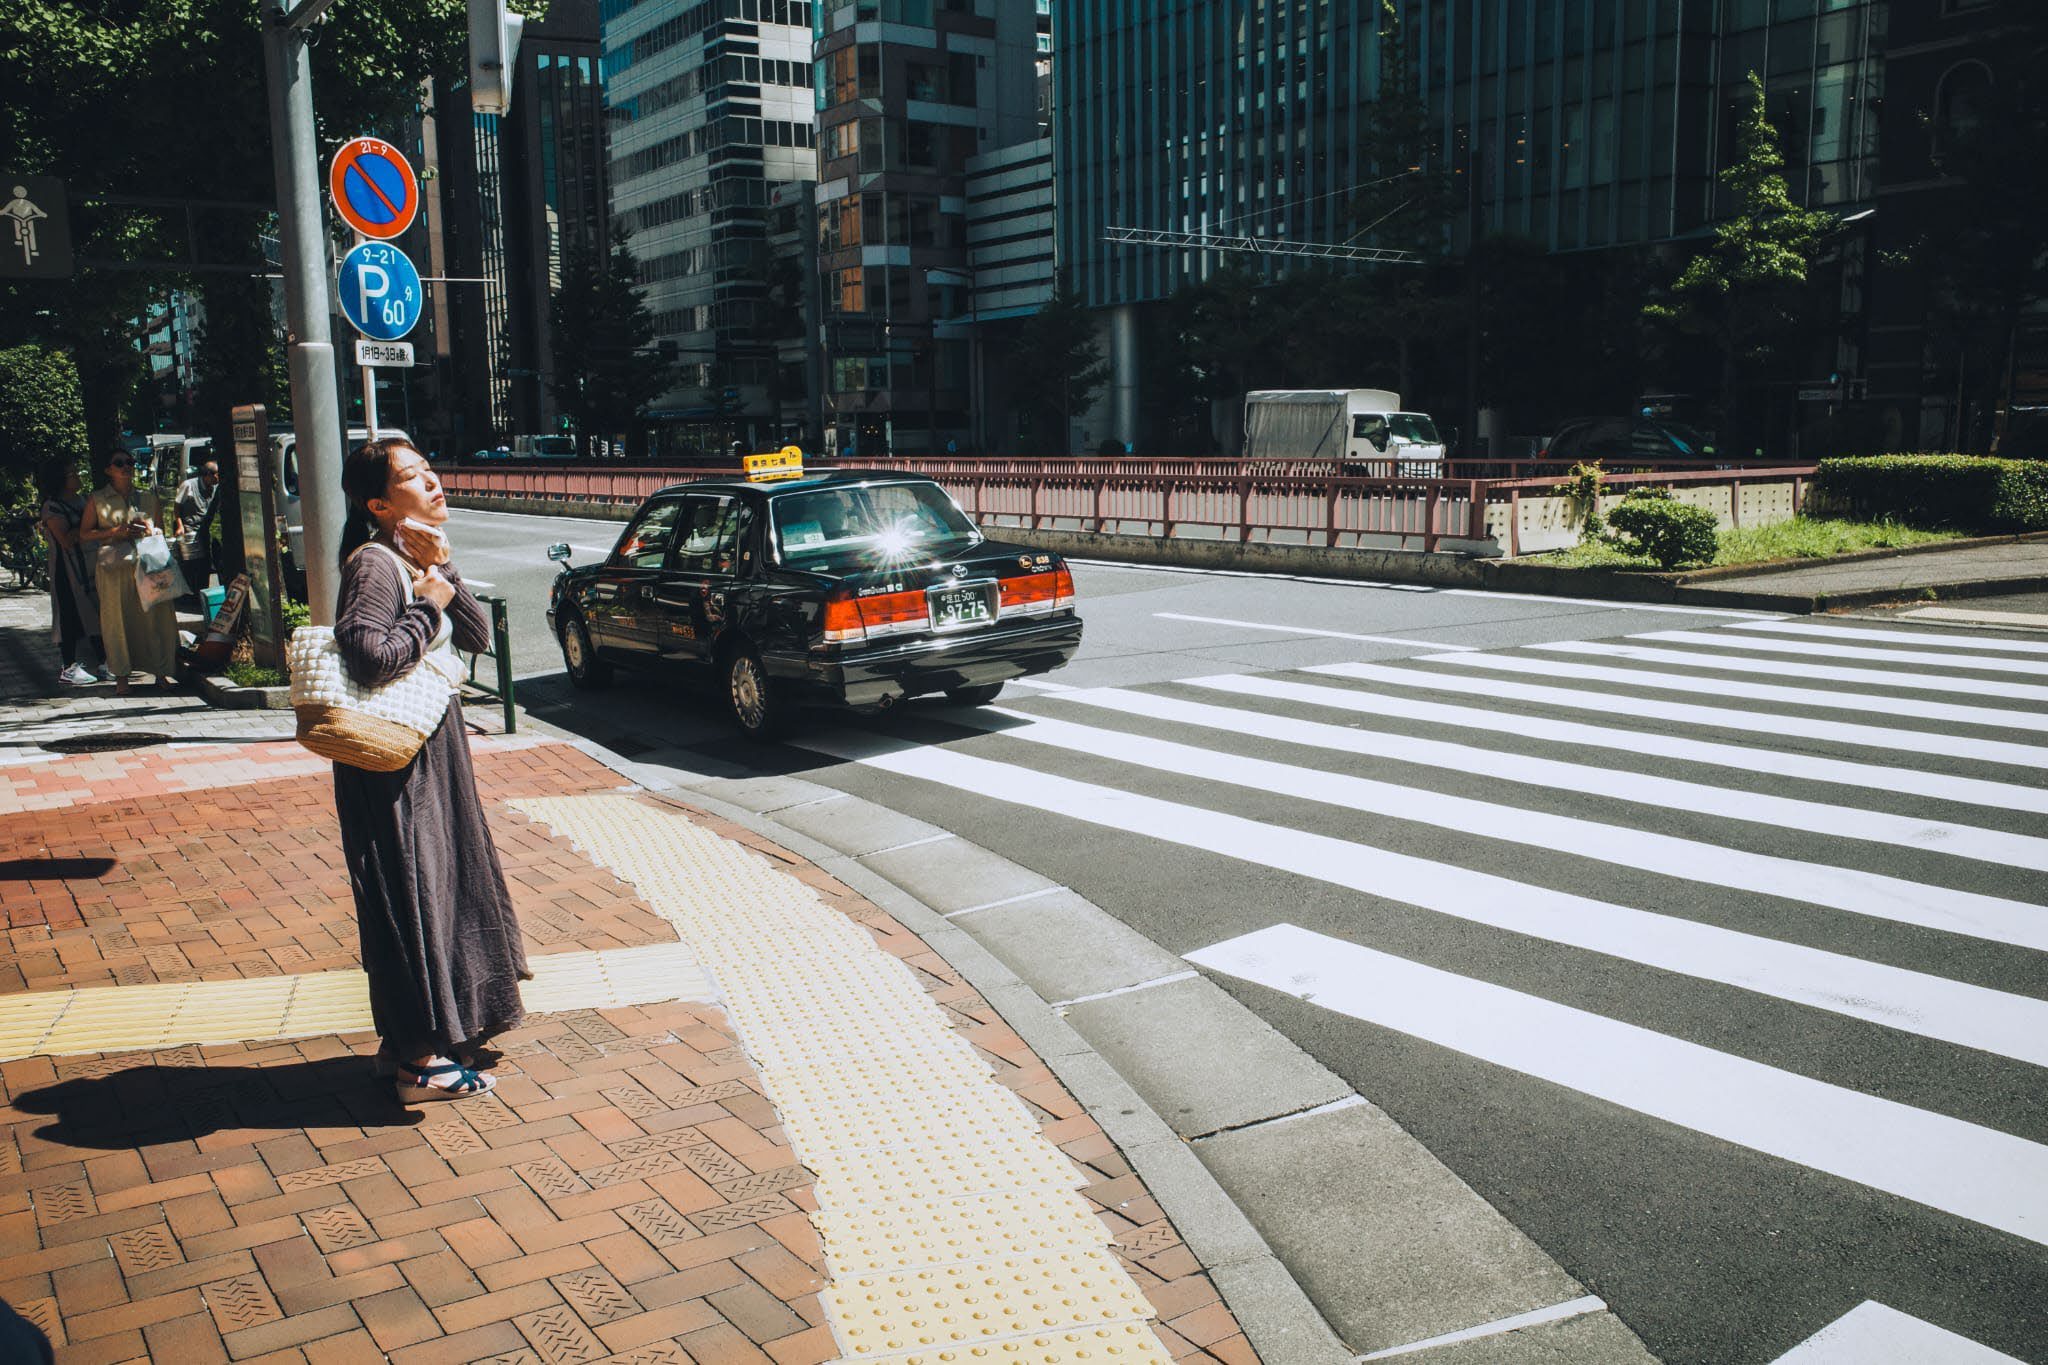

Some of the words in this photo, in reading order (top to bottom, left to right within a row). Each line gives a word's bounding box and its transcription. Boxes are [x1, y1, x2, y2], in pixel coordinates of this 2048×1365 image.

[360, 142, 387, 155] 21-9
[363, 248, 395, 264] 9-21
[358, 264, 389, 323] P
